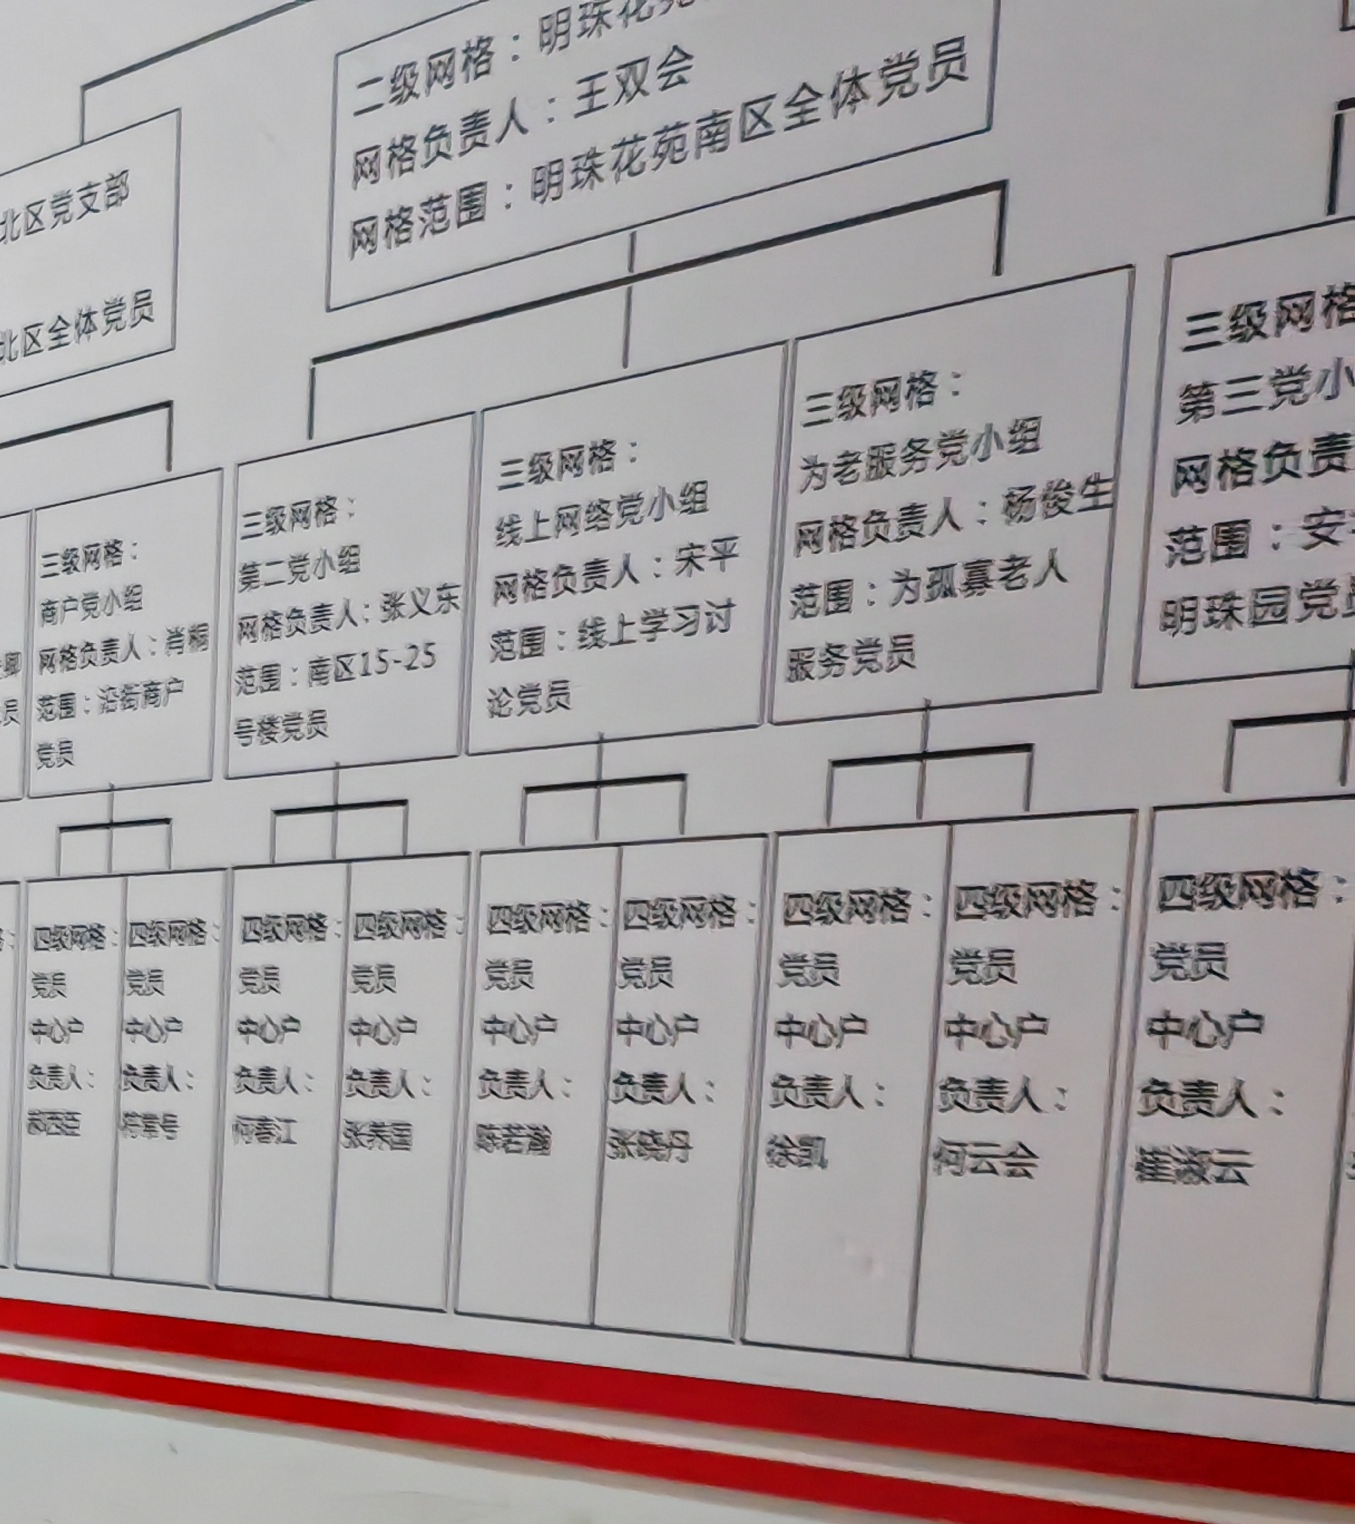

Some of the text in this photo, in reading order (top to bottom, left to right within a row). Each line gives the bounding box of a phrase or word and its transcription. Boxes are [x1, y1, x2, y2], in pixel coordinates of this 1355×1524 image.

[352, 0, 696, 117] 二级网格：明珠花
[352, 45, 694, 189] 网格负责人：王双会
[348, 36, 970, 259] 网格范围：明珠花苑南区全体党员
[801, 369, 962, 428] 三级网格：
[497, 438, 638, 492] 三级网格：
[798, 416, 1042, 494] 为老服务党小组
[240, 494, 355, 541] 三级网格：
[495, 479, 710, 549] 线上网络党小组
[1165, 505, 1355, 568] 范围：安
[790, 547, 1069, 621] 范围：为孤寡老人
[489, 598, 737, 665] 范围：线上学习讨
[785, 634, 917, 684] 服务党员
[487, 679, 572, 719] 论党员
[782, 886, 932, 928] 四级网格：
[953, 877, 1121, 922] 四级网格：
[1158, 867, 1348, 914] 四级网格：
[484, 956, 534, 991] 党员
[617, 955, 675, 990] 党员
[777, 952, 841, 988] 党员
[946, 945, 1019, 986] 党员
[1148, 941, 1230, 983] 党员
[29, 1016, 85, 1045] 中心户
[124, 1014, 184, 1044] 中心户
[236, 1014, 301, 1045] 中心户
[348, 1014, 418, 1046] 中心户
[481, 1012, 558, 1047] 中心户
[615, 1012, 700, 1048] 中心户
[774, 1011, 869, 1050] 中心户
[943, 1008, 1050, 1052] 中心户
[1145, 1008, 1266, 1051] 中心户
[233, 1064, 314, 1096] 负责人：
[344, 1066, 432, 1100] 负责人：
[477, 1067, 573, 1101] 负责人：
[609, 1070, 716, 1105] 负责人：
[768, 1072, 886, 1111] 负责人：
[937, 1074, 1068, 1115] 负责人：
[1135, 1075, 1285, 1120] 负责人：
